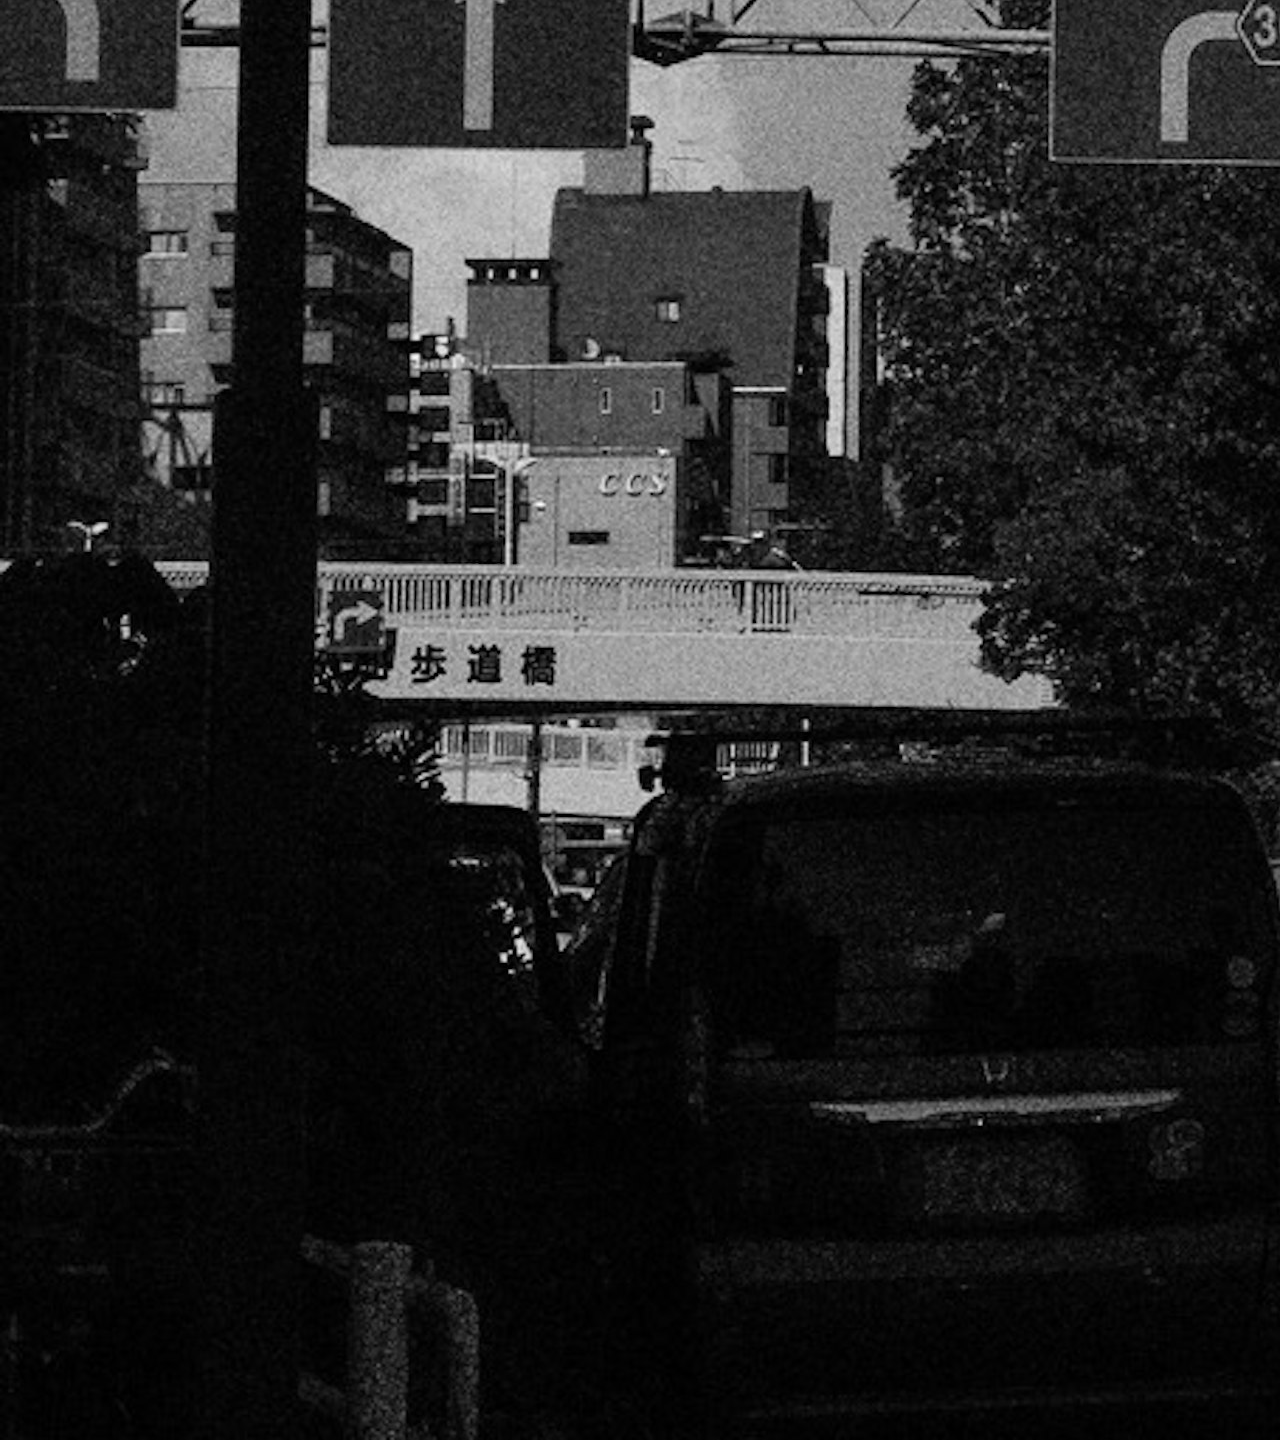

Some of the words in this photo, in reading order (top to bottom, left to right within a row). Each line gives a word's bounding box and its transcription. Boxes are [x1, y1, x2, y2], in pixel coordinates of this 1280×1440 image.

[598, 472, 669, 497] CCS
[410, 644, 557, 686] 歩道橋
